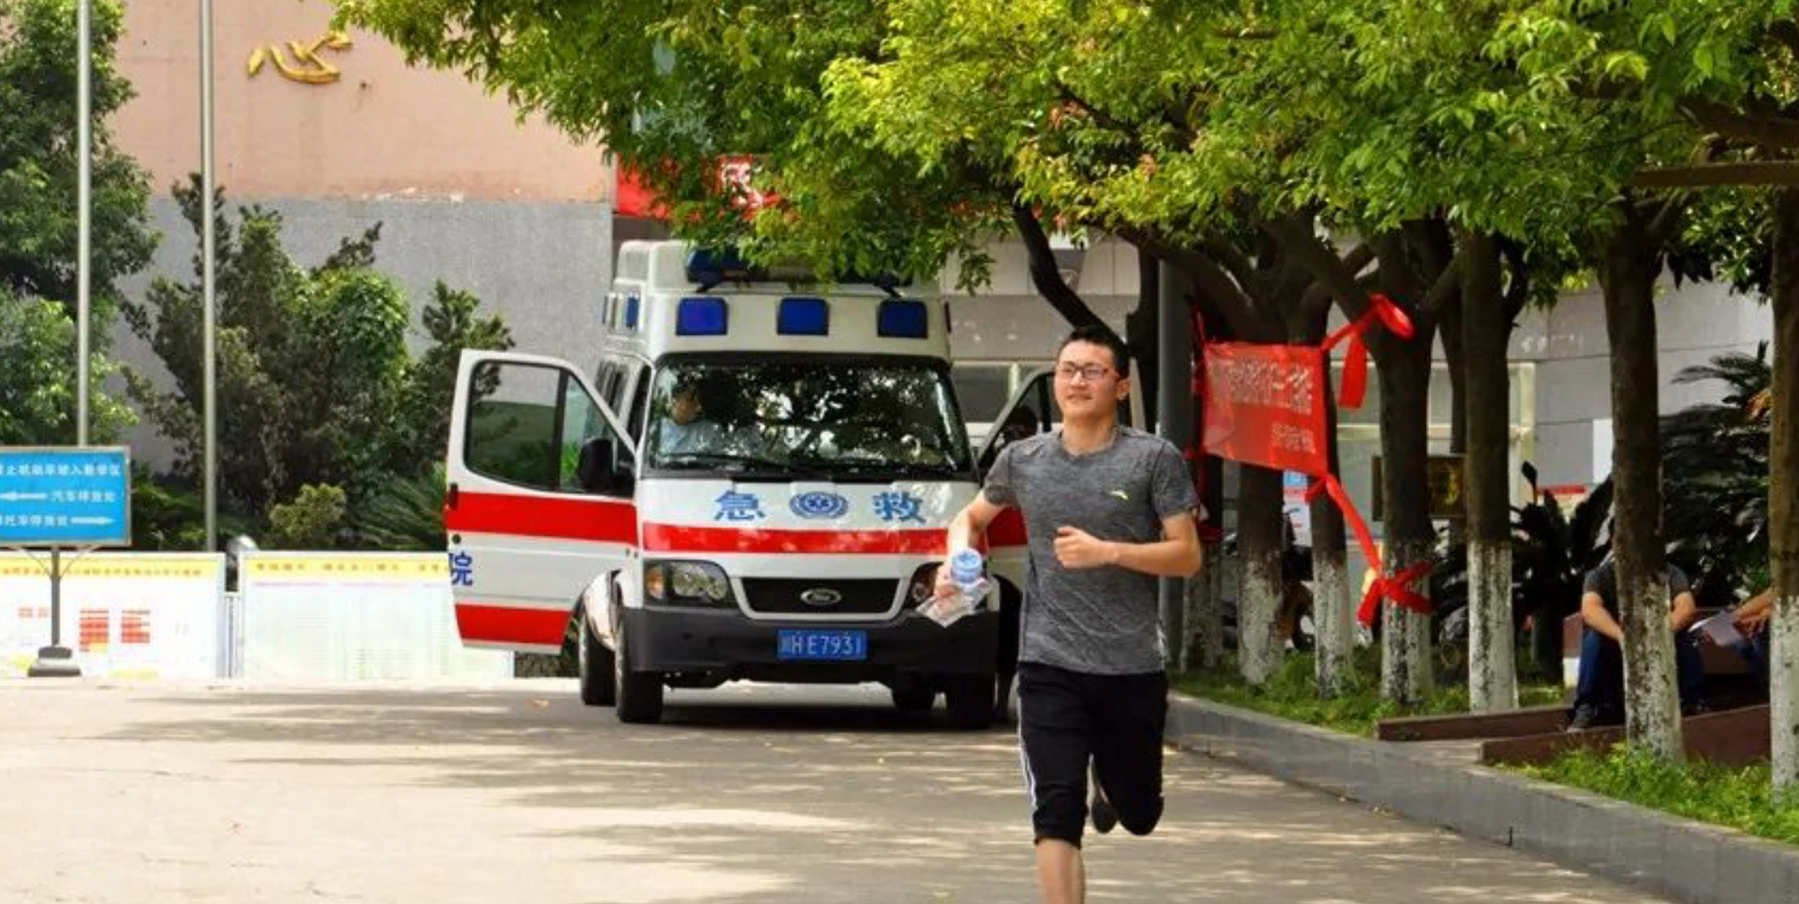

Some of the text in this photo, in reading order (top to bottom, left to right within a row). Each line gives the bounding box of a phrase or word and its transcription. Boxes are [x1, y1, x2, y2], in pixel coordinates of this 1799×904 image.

[714, 490, 927, 524] 急 救
[0, 515, 67, 527] 托车停放处
